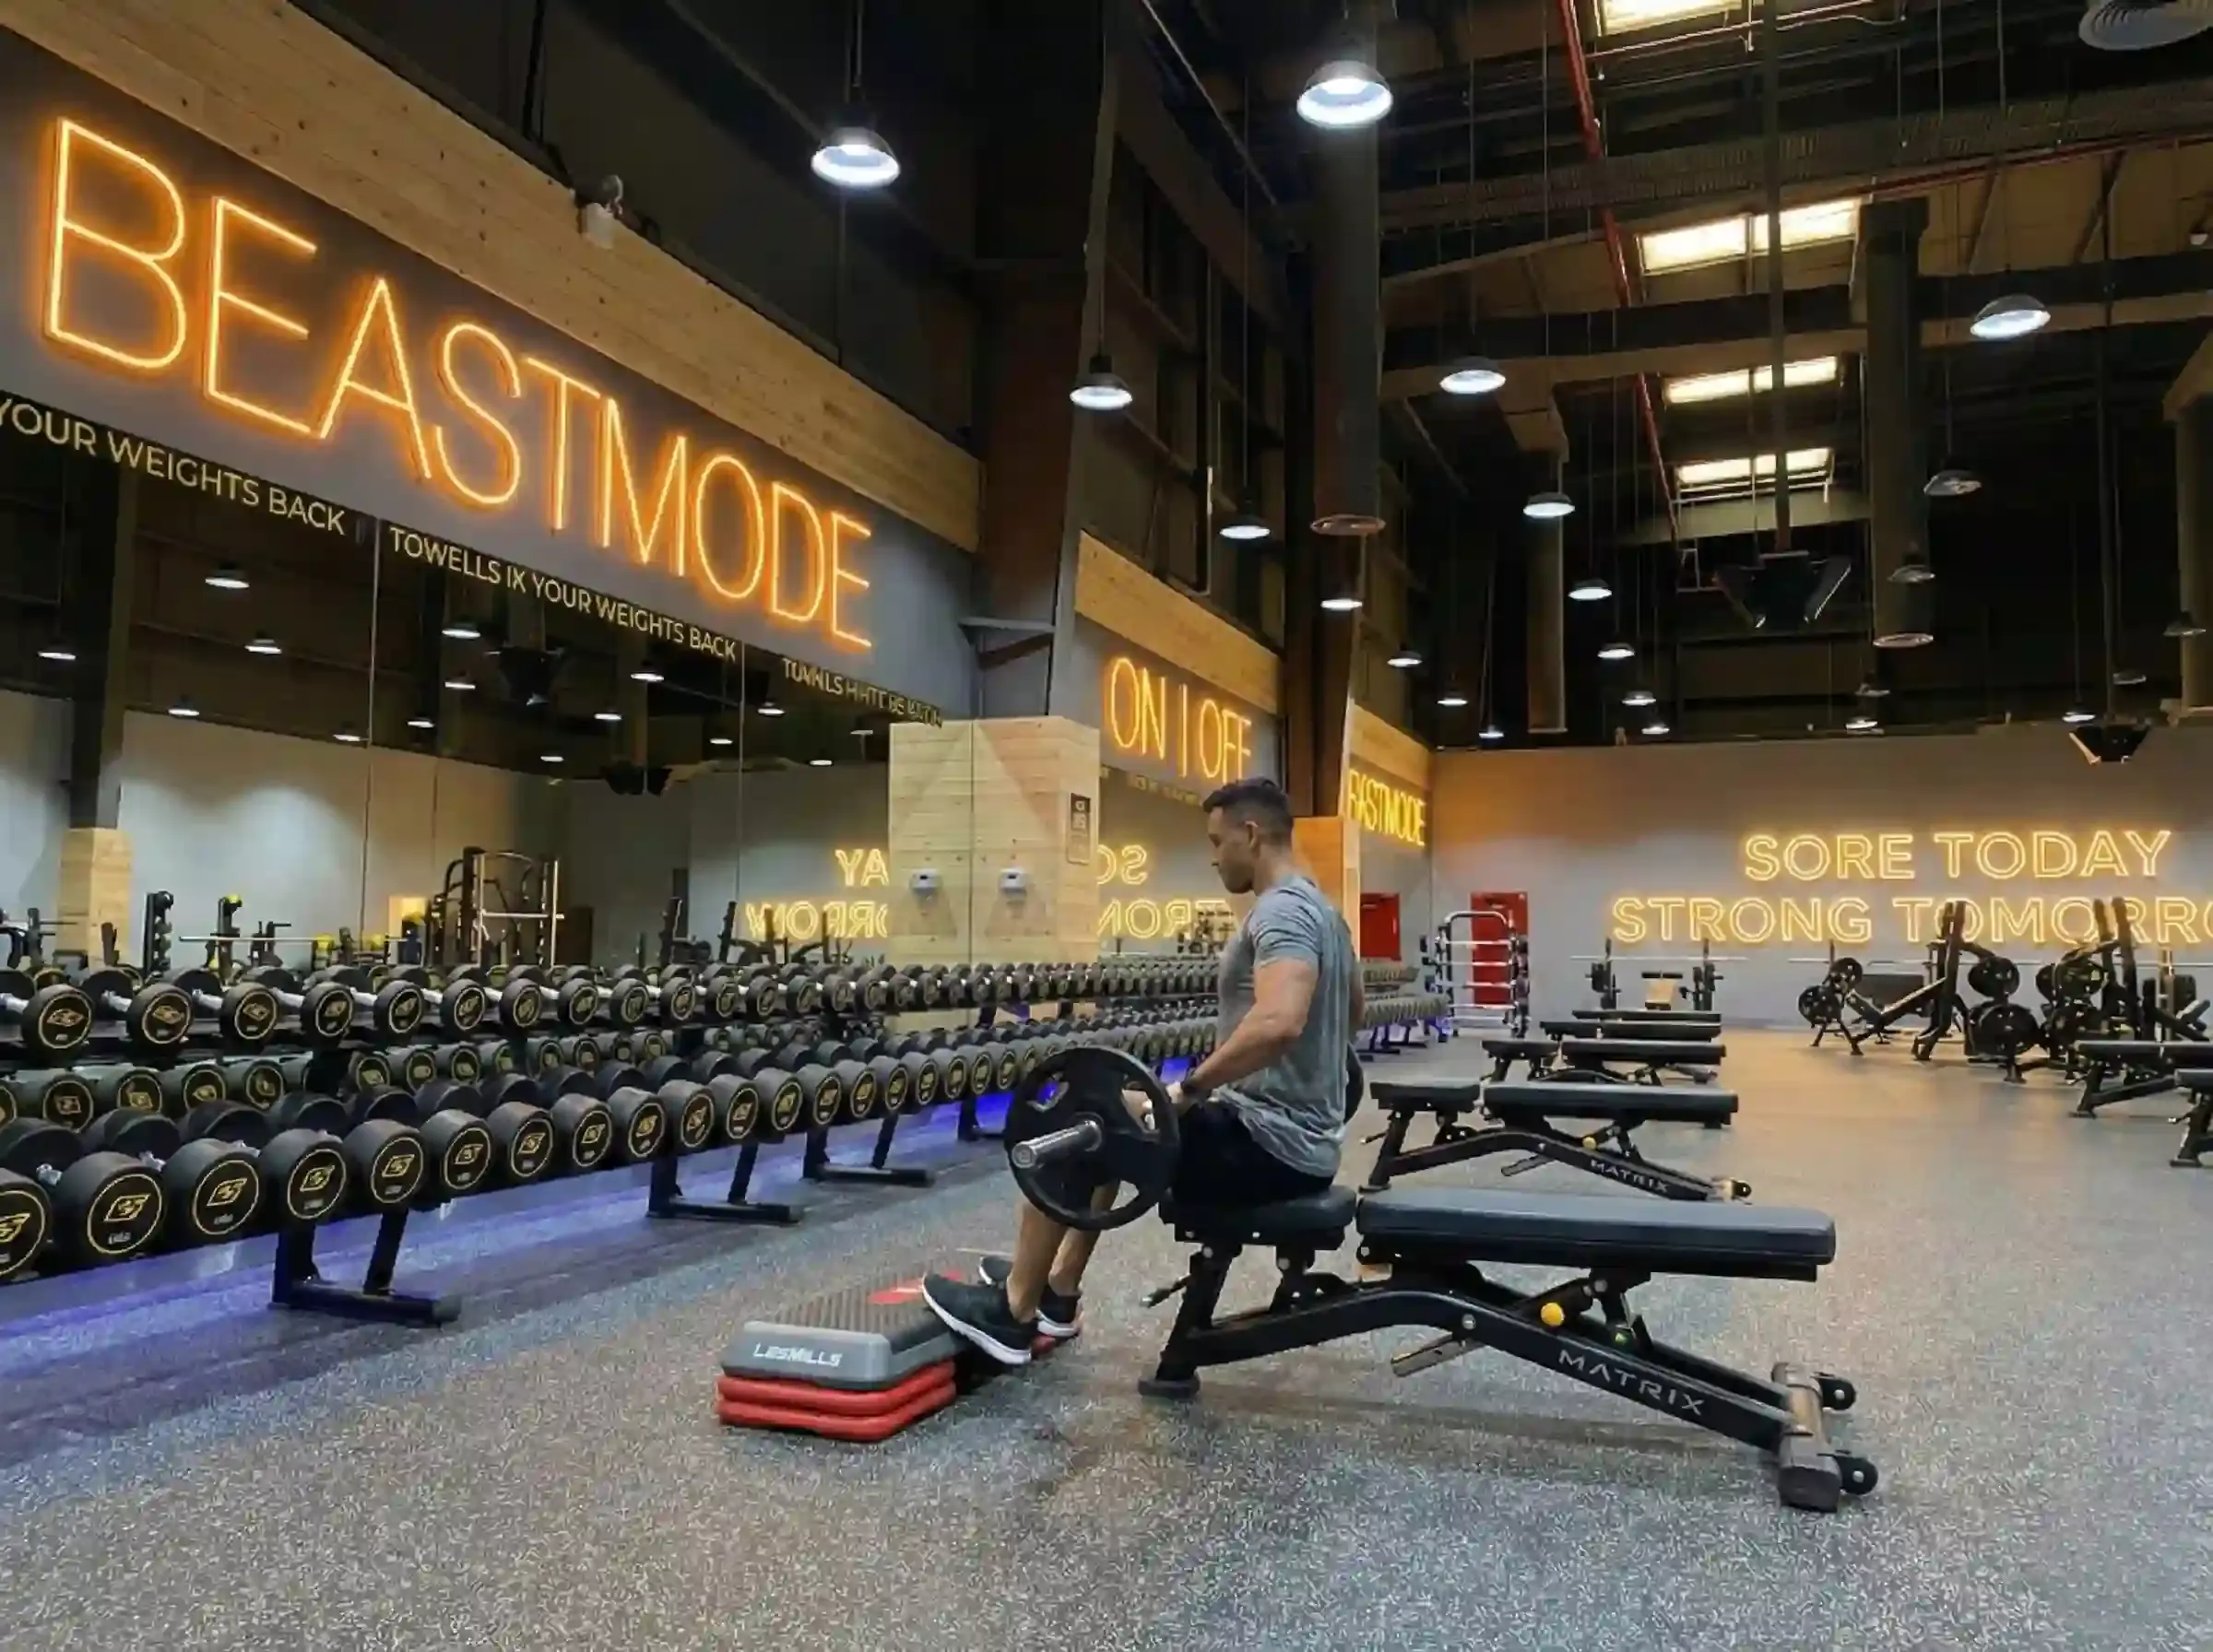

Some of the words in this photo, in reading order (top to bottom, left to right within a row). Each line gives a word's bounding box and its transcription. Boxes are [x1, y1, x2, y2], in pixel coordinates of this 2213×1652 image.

[48, 118, 872, 650] BEASTMODE
[107, 431, 259, 506] WEIGHTS
[268, 487, 345, 536] BACK
[389, 526, 501, 584] TOWELLS
[532, 572, 591, 614] YOUR
[596, 595, 684, 643] WEIGHTS
[689, 627, 736, 663] BACK
[1110, 657, 1166, 761] ON
[1199, 698, 1252, 786] OFF
[1743, 833, 1916, 882] SORE
[1934, 830, 2172, 879] TODAY
[1611, 896, 1873, 944] STRONG
[1892, 896, 2213, 945] TOMORR
[1557, 1349, 1705, 1417] MATRIX
